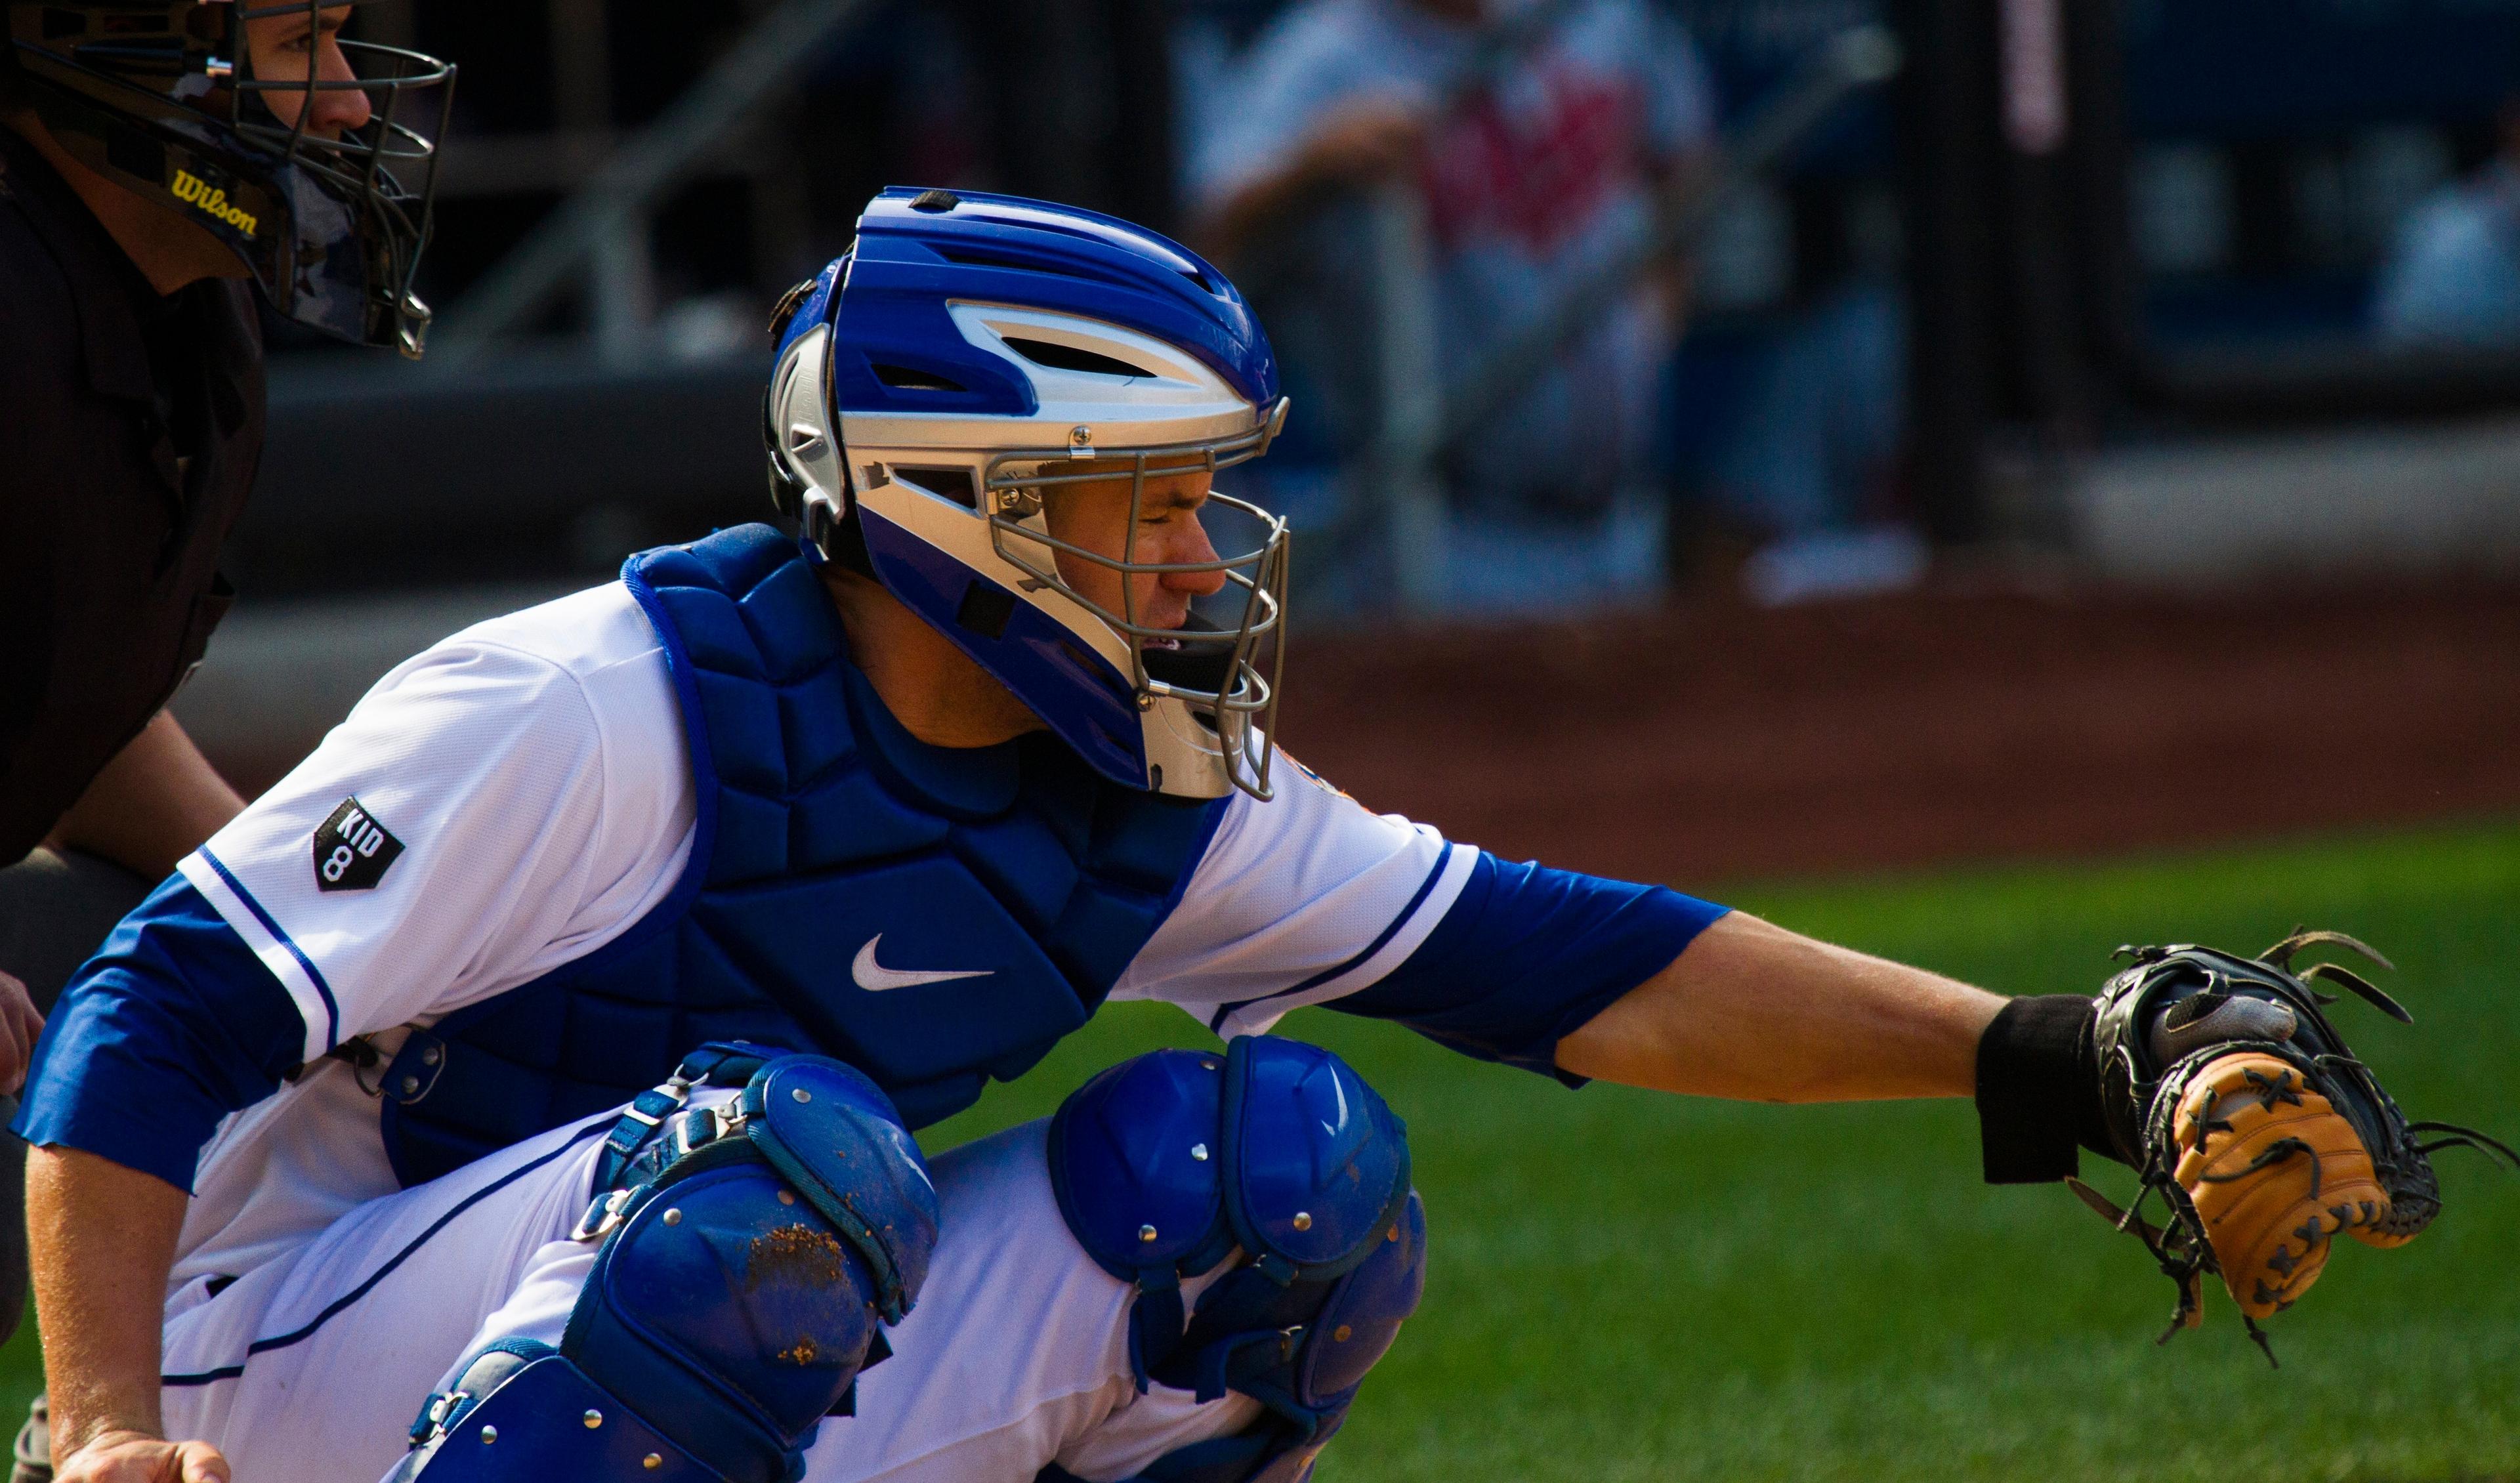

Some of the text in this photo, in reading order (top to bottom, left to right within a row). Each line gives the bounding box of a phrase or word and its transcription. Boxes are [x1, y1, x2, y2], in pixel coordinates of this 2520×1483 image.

[172, 169, 257, 236] Wilson
[337, 808, 385, 858] KID
[323, 845, 353, 882] 8
